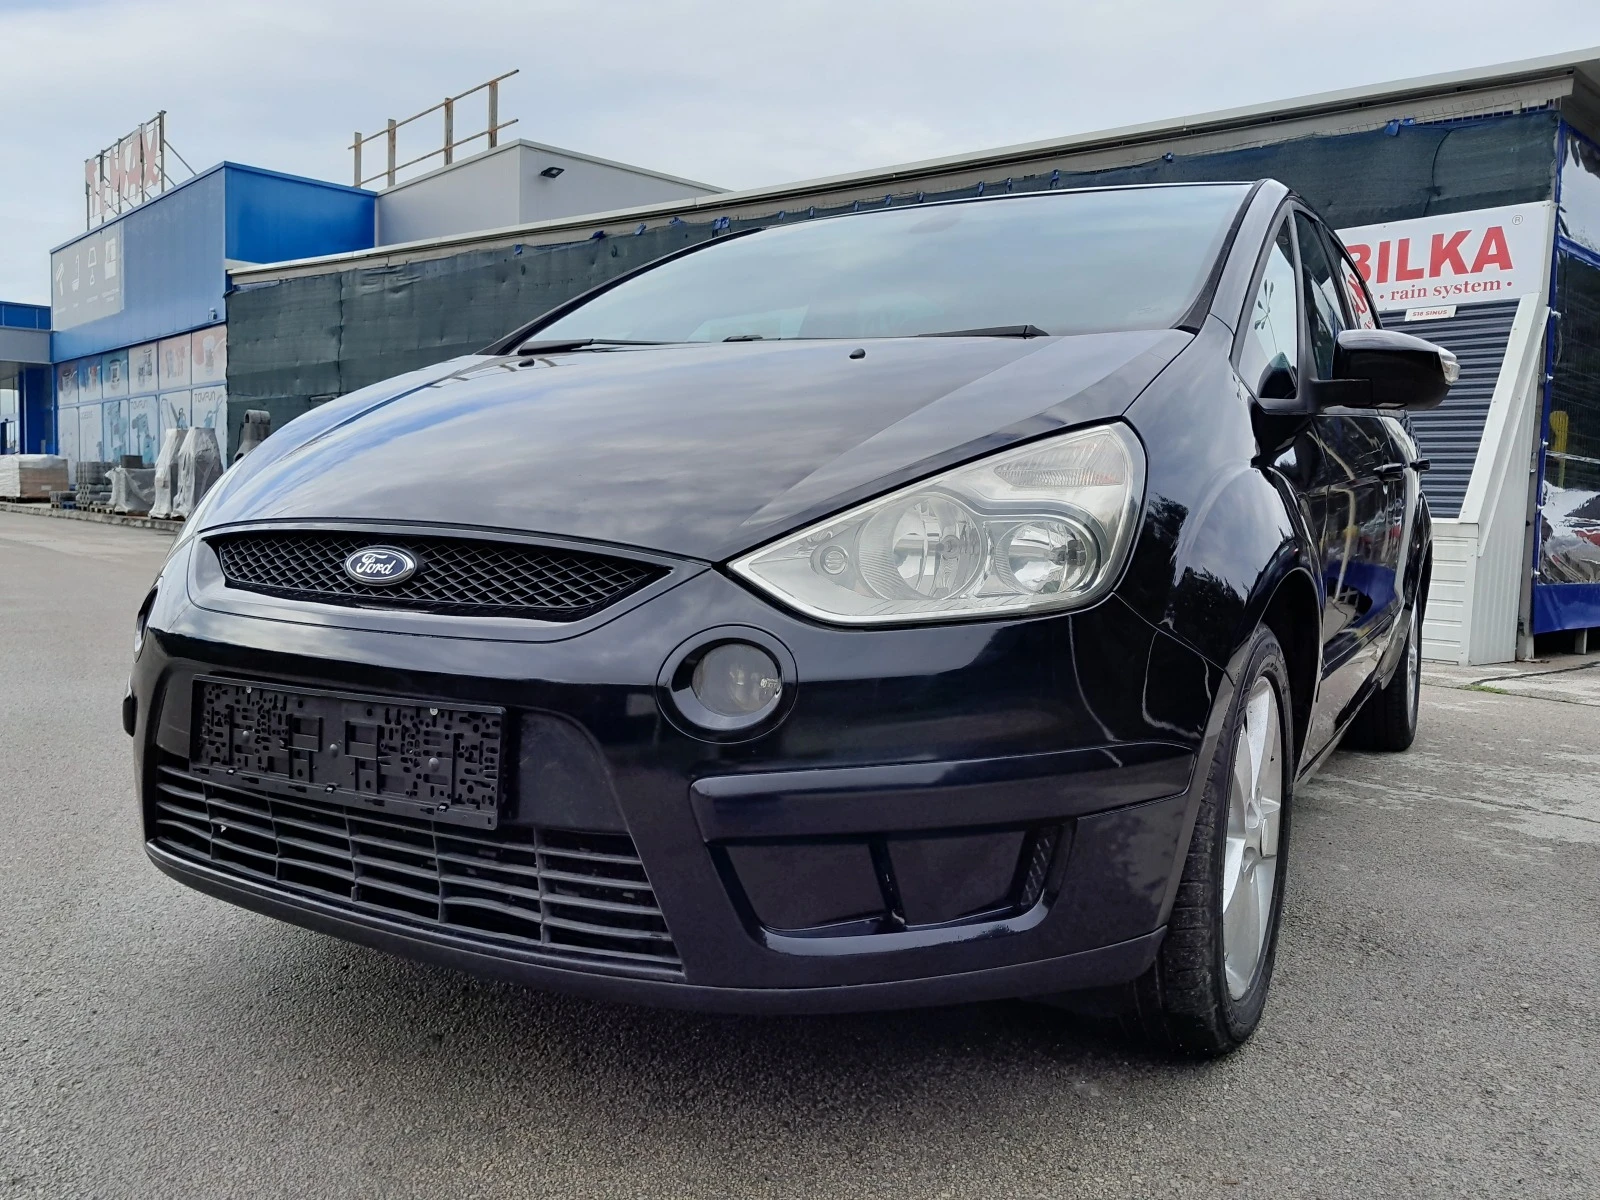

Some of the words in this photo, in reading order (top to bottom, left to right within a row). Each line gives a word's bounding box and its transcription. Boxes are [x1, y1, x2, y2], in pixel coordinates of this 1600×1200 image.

[1345, 226, 1513, 284] BILKA
[1390, 284, 1427, 300] rain
[1433, 280, 1501, 299] system
[356, 553, 397, 574] Ford
